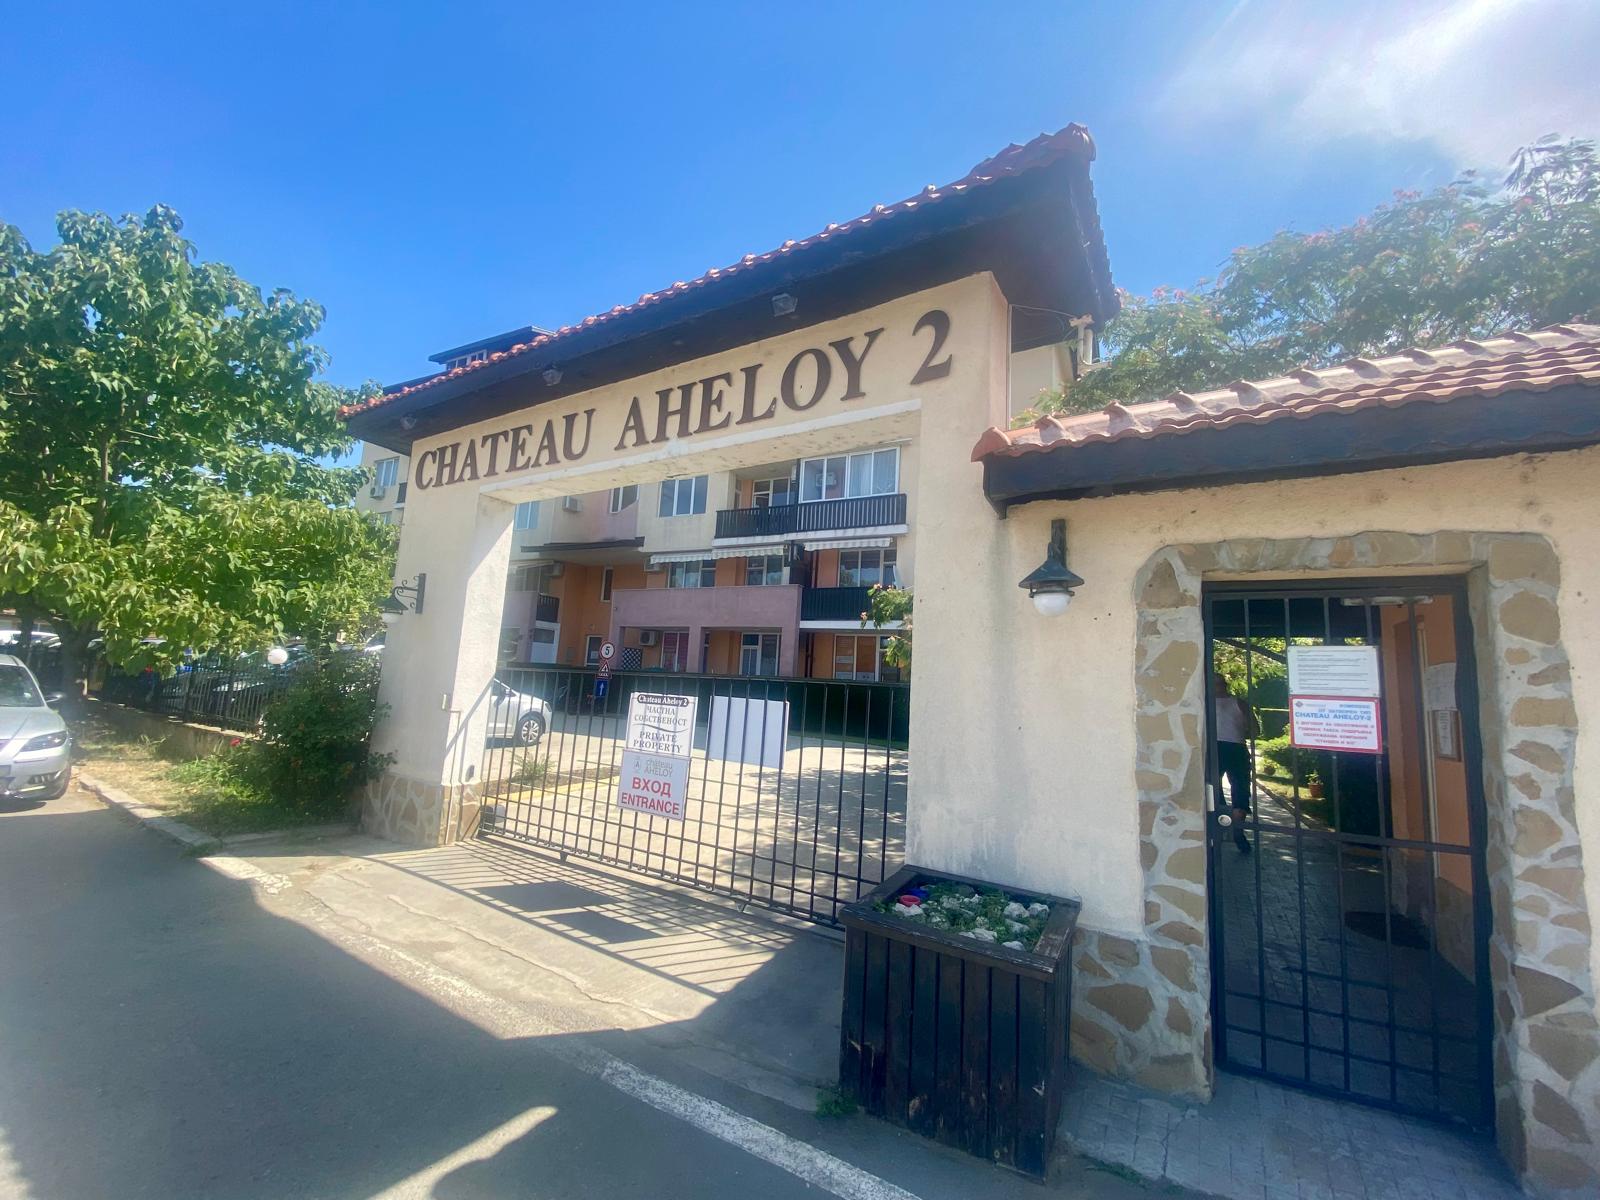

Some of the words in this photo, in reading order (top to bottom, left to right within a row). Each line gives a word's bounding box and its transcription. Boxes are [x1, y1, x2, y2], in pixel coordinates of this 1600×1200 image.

[415, 408, 597, 490] CHATEAU
[614, 327, 885, 451] AHELOY
[911, 309, 954, 386] 2
[604, 645, 611, 656] 5
[639, 694, 662, 704] Chateau
[662, 697, 683, 706] Aheloy
[683, 698, 688, 706] 2
[647, 706, 676, 716] ЧАСТНА
[1295, 711, 1330, 719] CHATEAU
[634, 714, 688, 727] СОБСТВЕНОСТ
[639, 731, 678, 743] PRIVATE
[633, 739, 682, 754] PROPERTY
[644, 766, 673, 778] AHELOY
[632, 777, 672, 798] ВХОД
[621, 792, 680, 816] ENTRANCE
